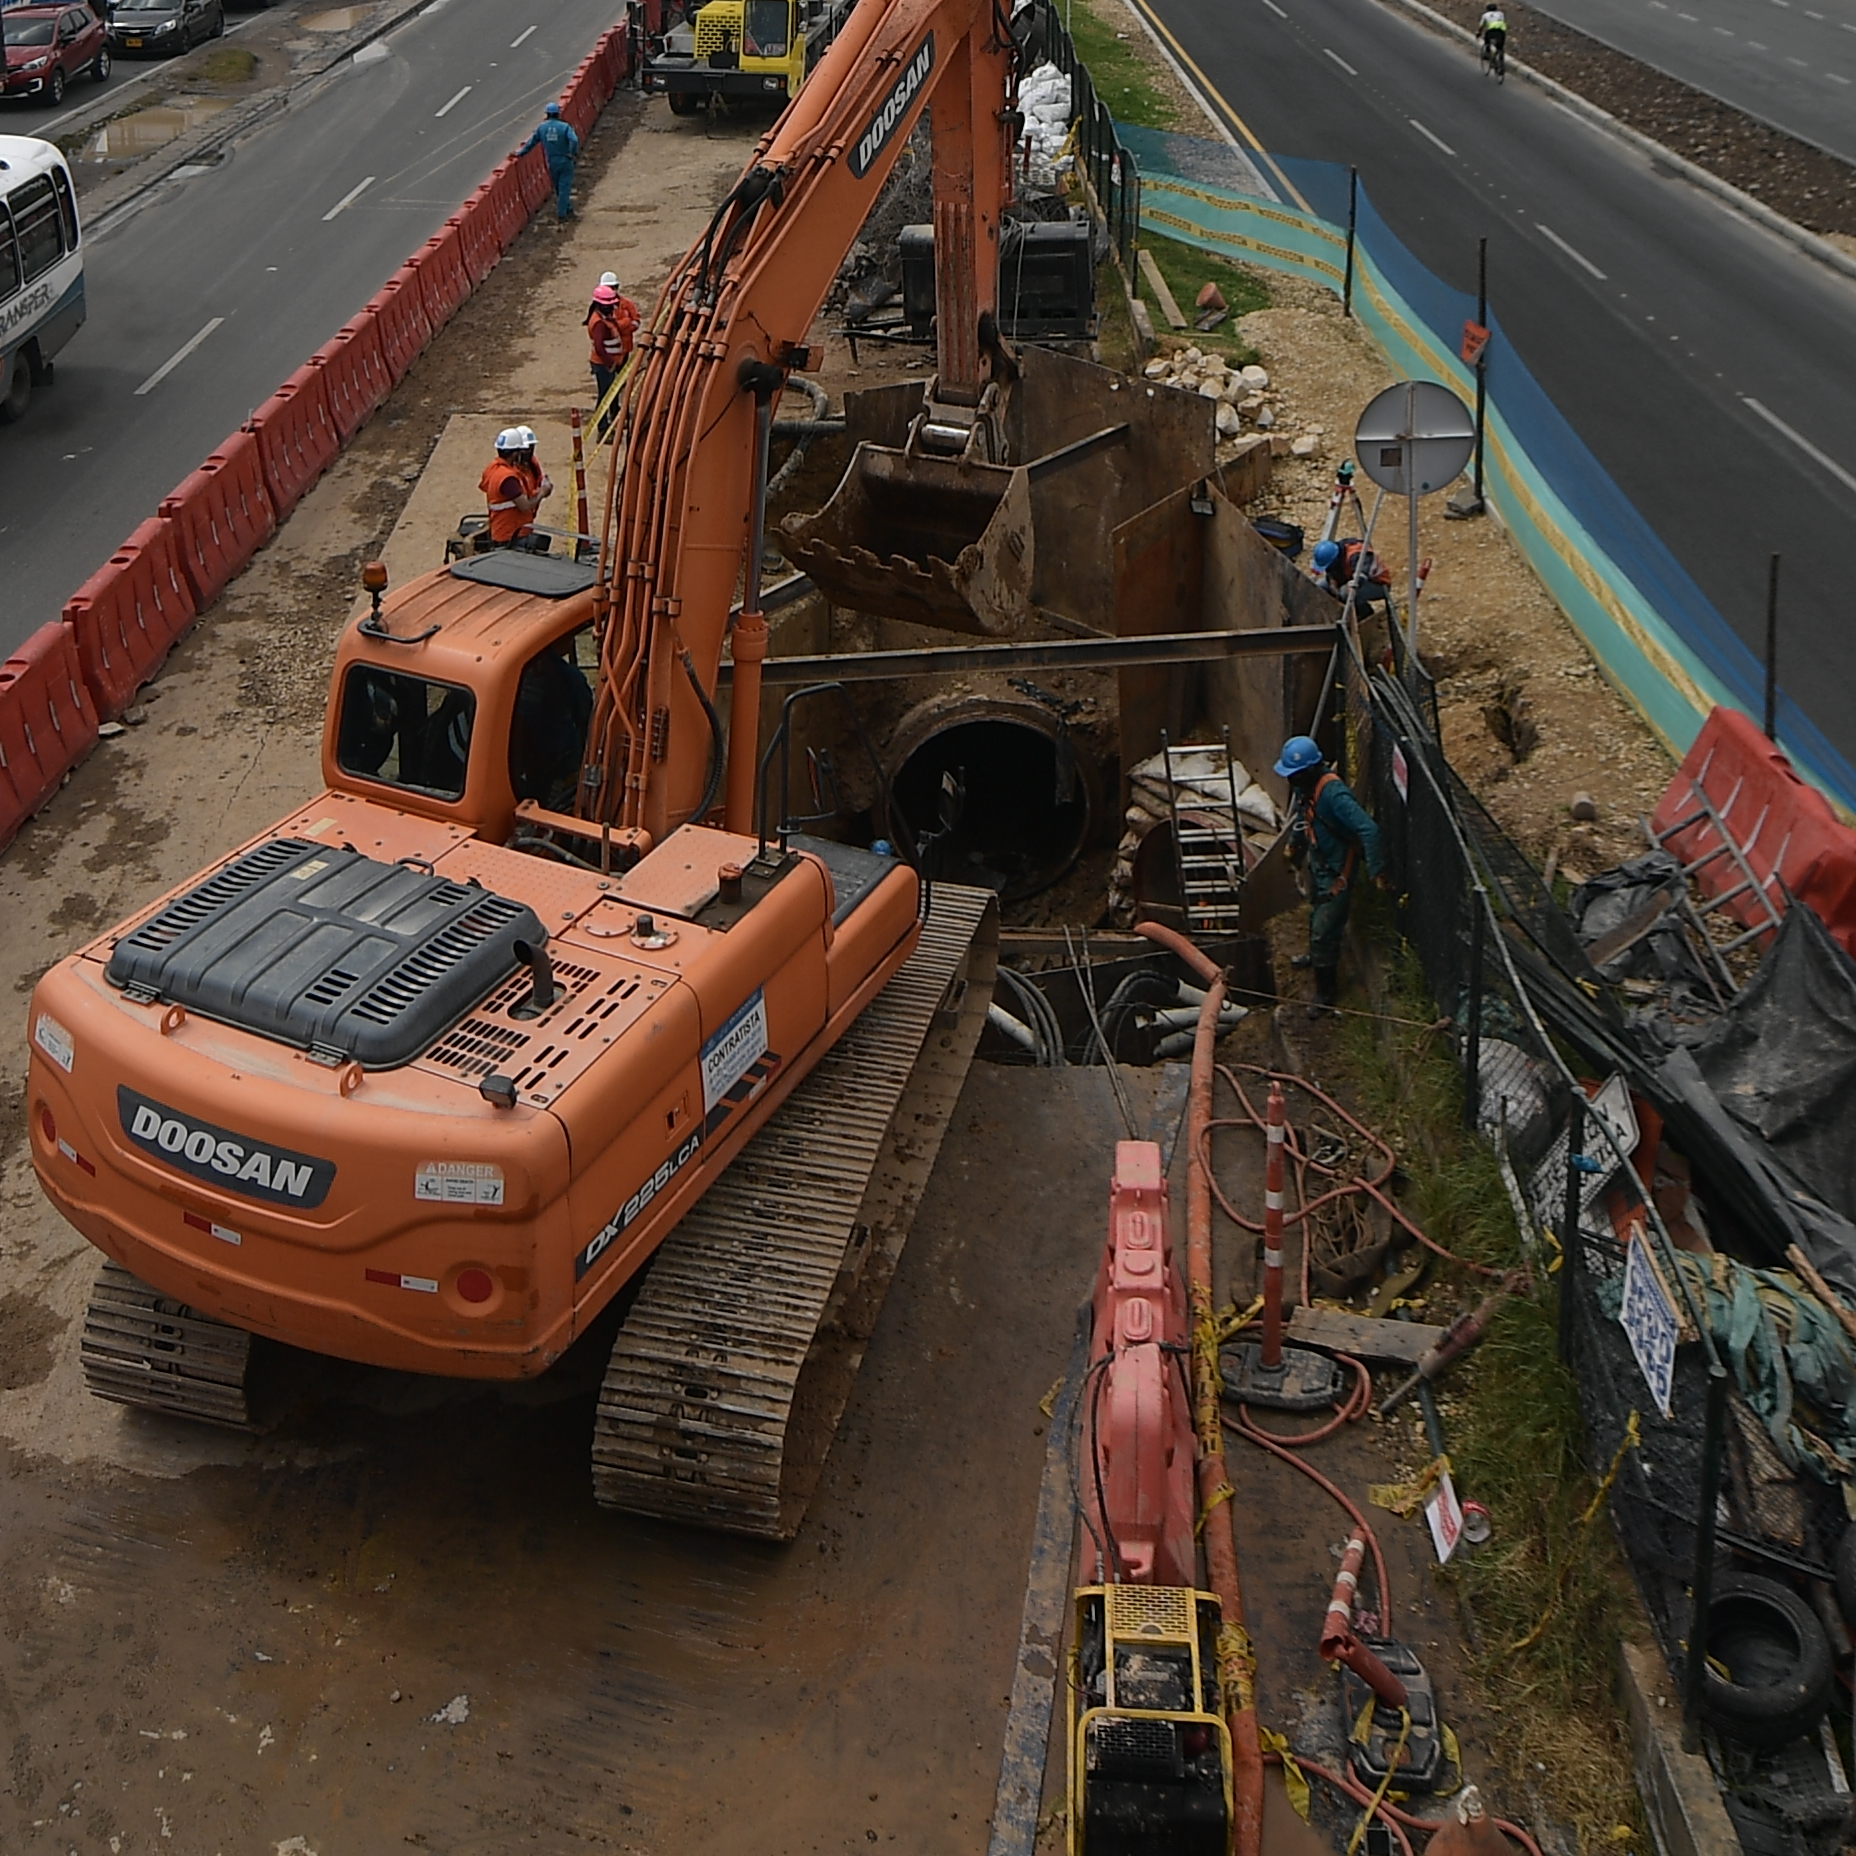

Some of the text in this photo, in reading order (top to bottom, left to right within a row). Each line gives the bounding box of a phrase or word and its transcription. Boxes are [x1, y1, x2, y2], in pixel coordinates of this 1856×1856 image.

[859, 43, 931, 171] DOOSAN
[708, 1009, 761, 1074] CONTRATISTA
[131, 1104, 315, 1198] DOOSAN
[438, 1162, 494, 1178] DANGER
